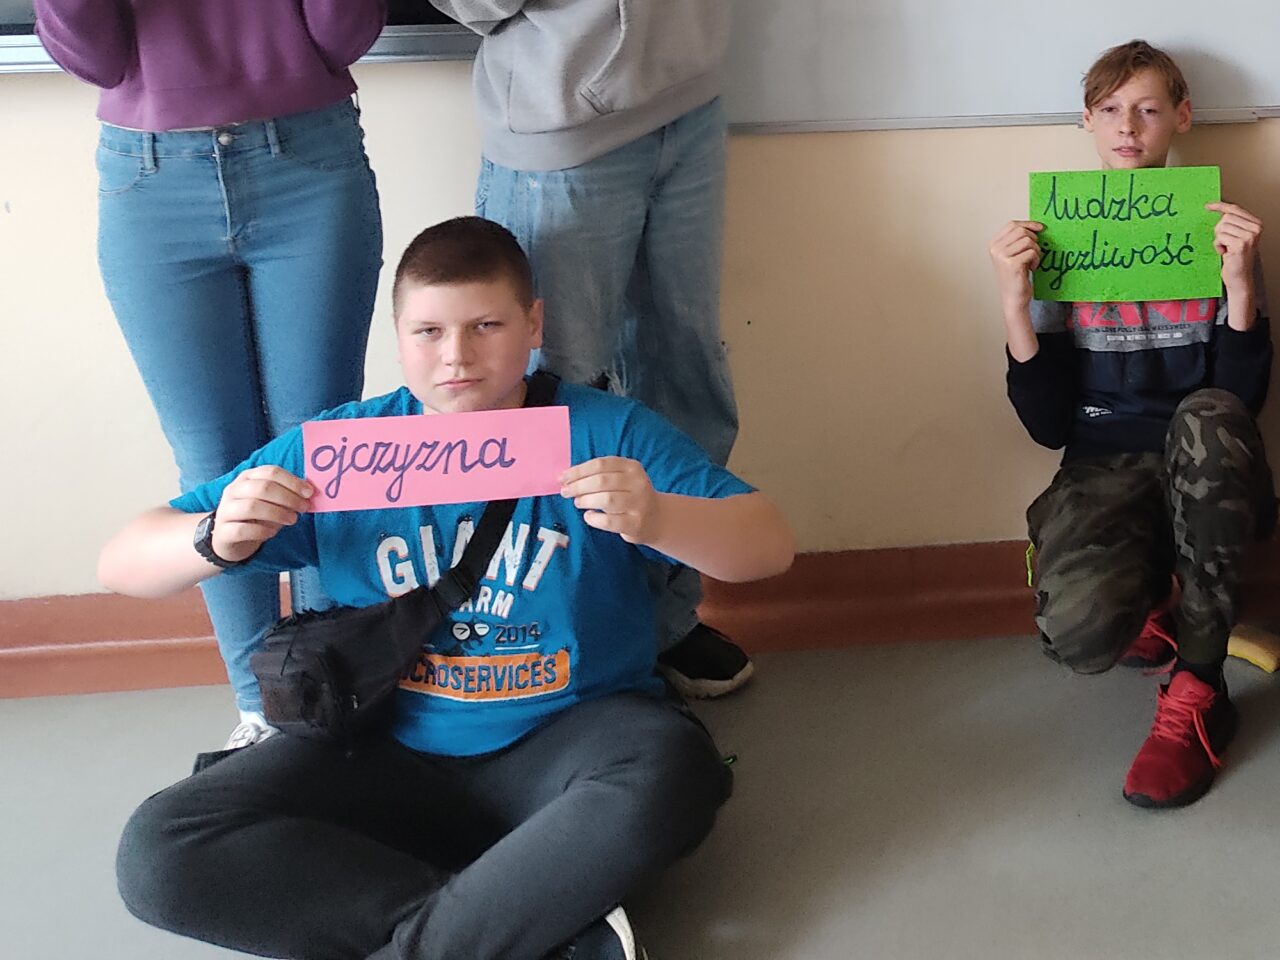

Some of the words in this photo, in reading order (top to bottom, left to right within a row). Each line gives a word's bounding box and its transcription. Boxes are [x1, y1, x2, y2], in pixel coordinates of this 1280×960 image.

[1043, 173, 1178, 222] ludzka
[1038, 229, 1195, 291] życzliwość
[310, 437, 516, 502] ojczyzna
[459, 586, 514, 619] ARM
[494, 621, 541, 644] 2014
